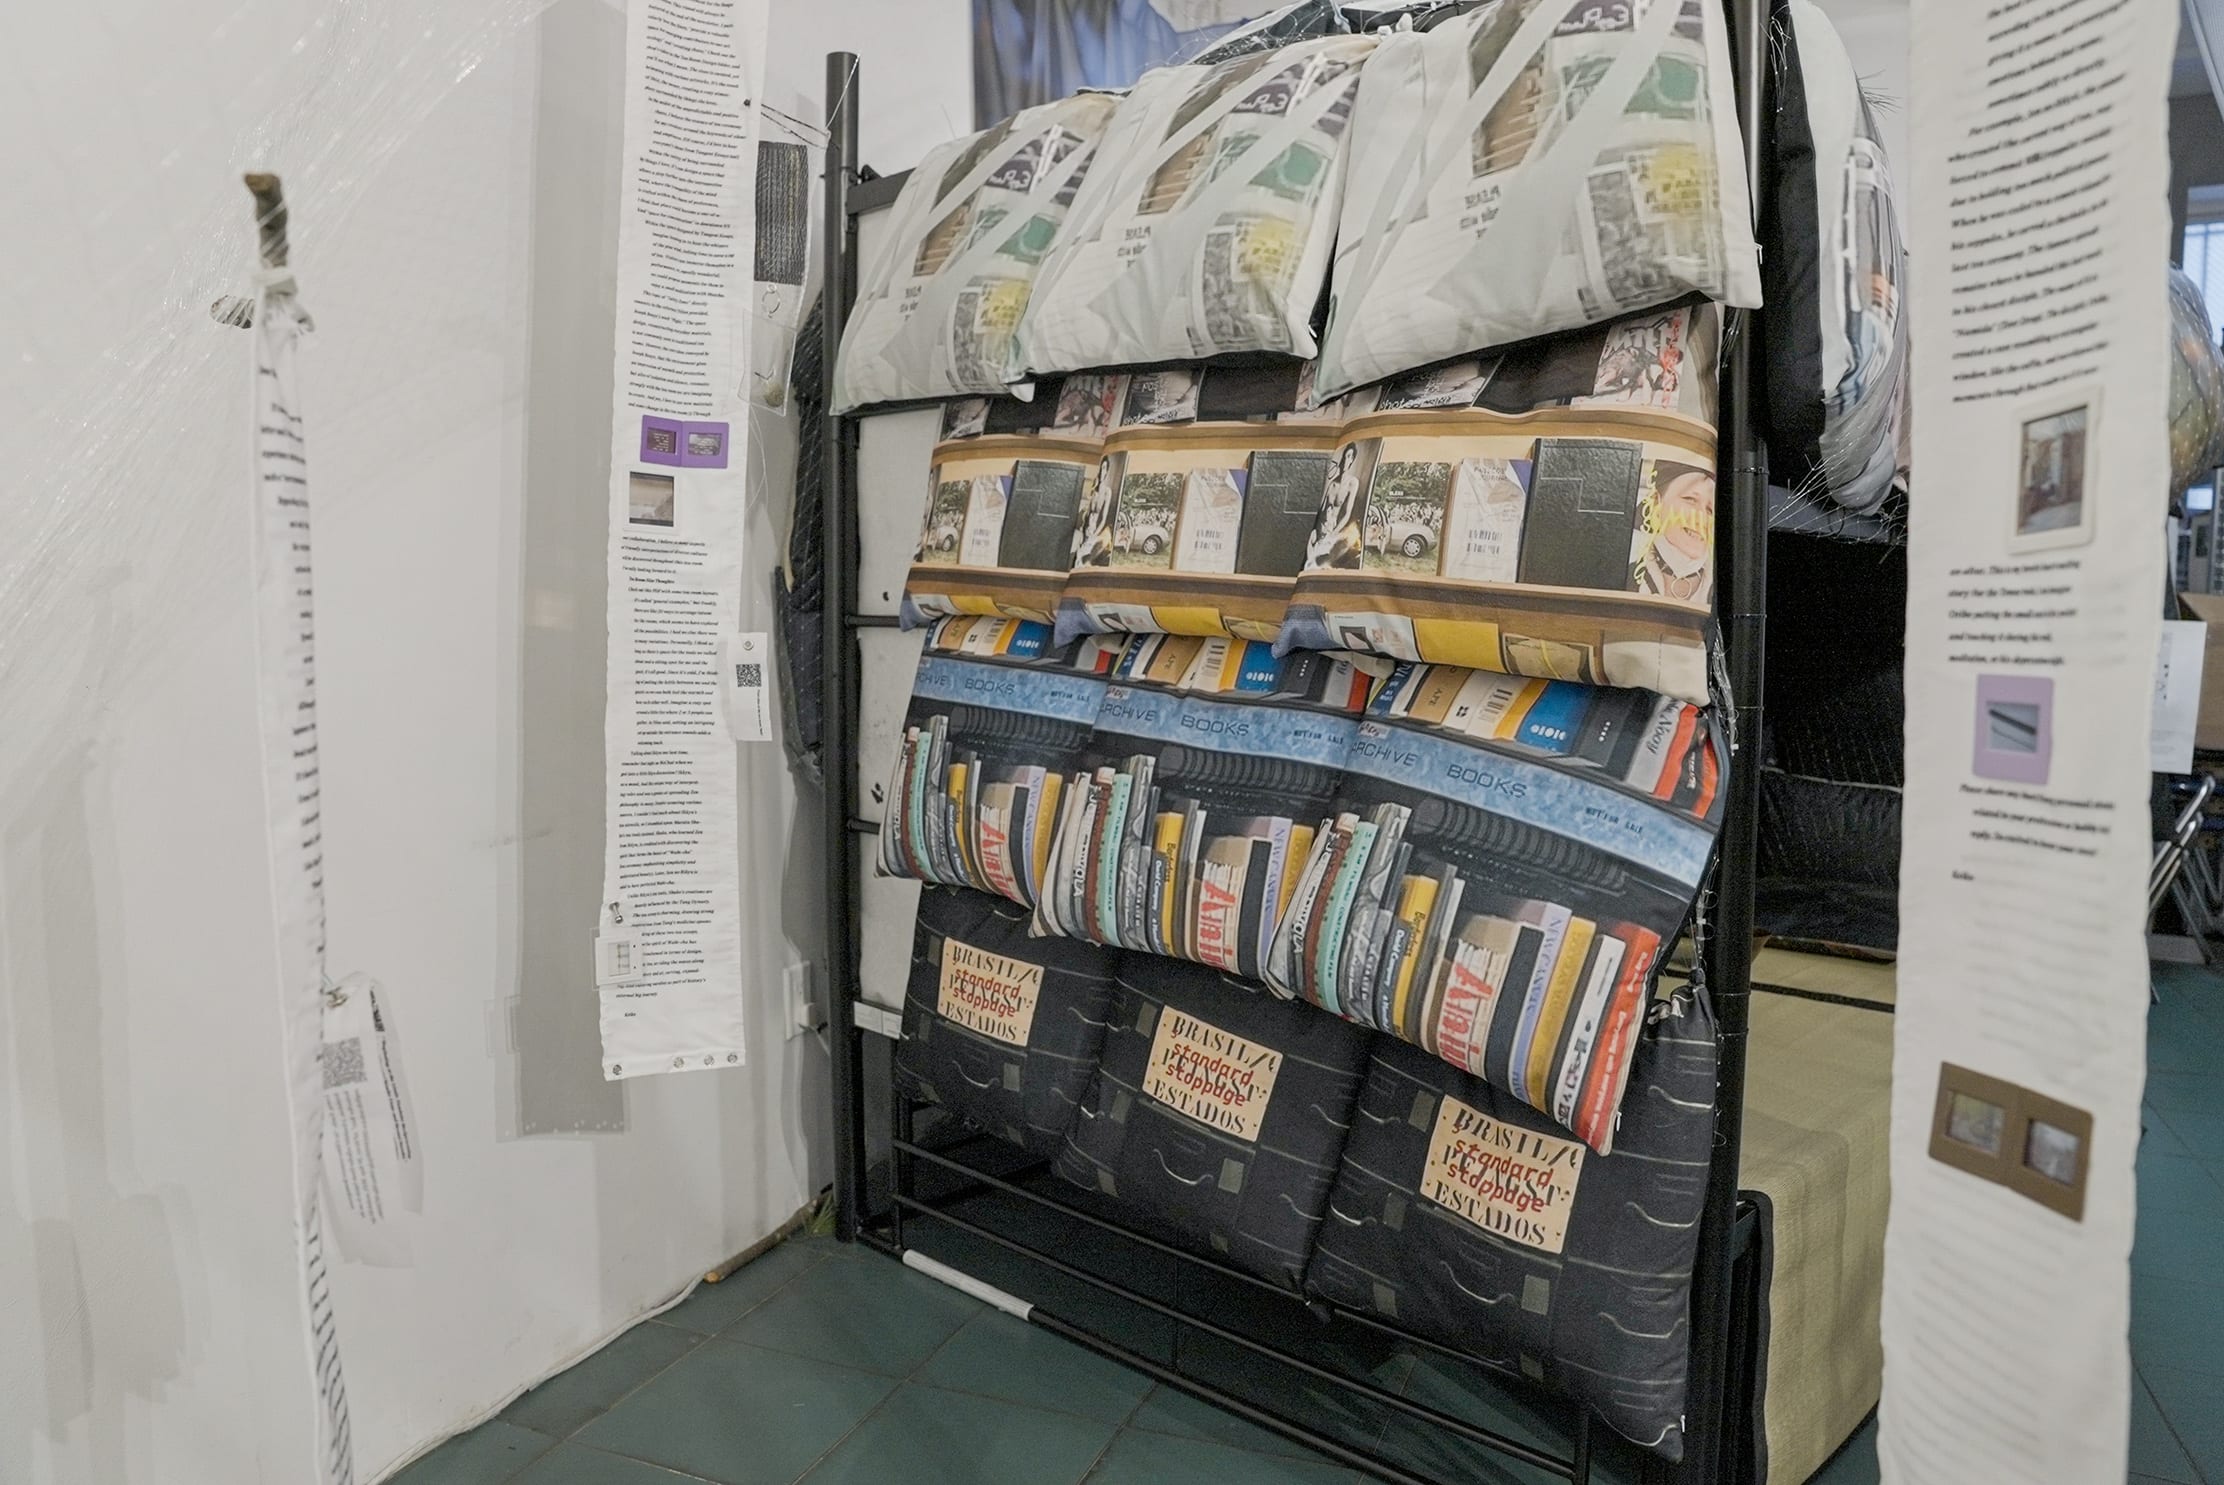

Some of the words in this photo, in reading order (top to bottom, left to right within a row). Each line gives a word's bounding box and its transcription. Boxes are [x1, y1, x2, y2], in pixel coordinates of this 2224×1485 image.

[965, 678, 1015, 696] BOOKS
[1181, 714, 1249, 737] BOOKS
[1447, 764, 1528, 799] BOOKS
[953, 986, 1016, 1017] stoppage
[956, 968, 1021, 999] standard
[945, 1001, 1017, 1041] ESTADOS
[1166, 1063, 1246, 1107] stoppage
[1173, 1043, 1254, 1087] standard
[1154, 1079, 1245, 1134] ESTADOS
[1455, 1139, 1554, 1190] standard
[1447, 1163, 1545, 1213] stoppage
[1433, 1181, 1546, 1246] ESTADOS
